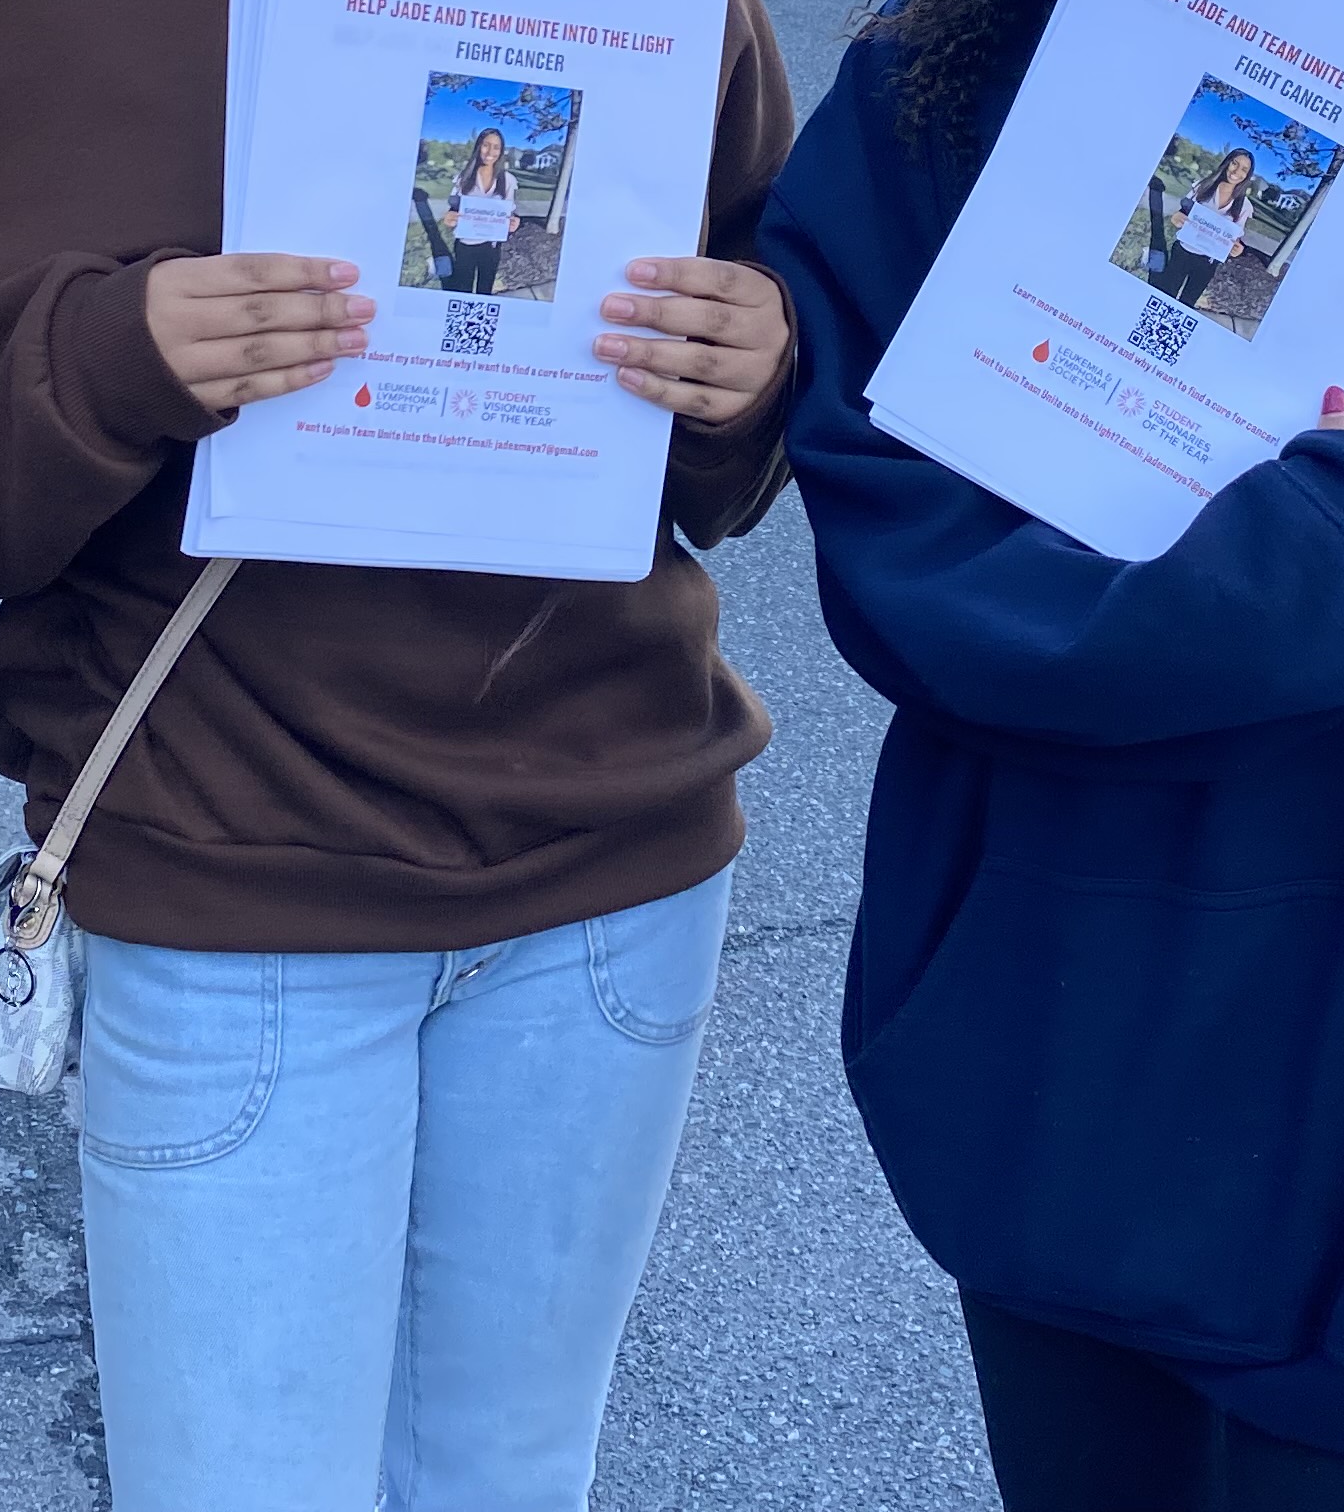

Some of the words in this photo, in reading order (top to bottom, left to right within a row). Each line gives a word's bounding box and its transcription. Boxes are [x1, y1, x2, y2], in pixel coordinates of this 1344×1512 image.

[390, 0, 432, 22] JADE
[434, 6, 466, 27] AND
[470, 10, 512, 33] TEAM
[515, 17, 561, 40] UNITE
[562, 23, 598, 45] INTO
[601, 29, 629, 49] THE
[632, 33, 675, 55] LIGHT
[1225, 14, 1259, 42] AND
[1259, 30, 1303, 65] TEAM
[455, 41, 502, 64] FIGHT
[505, 47, 565, 72] CANCER
[1234, 54, 1282, 90] FIGHT
[1280, 79, 1343, 124] CANCER
[1012, 284, 1036, 304] Learn
[1036, 299, 1058, 316] more
[1058, 312, 1083, 330] about
[1082, 326, 1095, 339] my
[1095, 332, 1119, 352] story
[1118, 347, 1135, 361] and
[1134, 355, 1152, 373] why
[1156, 369, 1179, 387] want
[1177, 380, 1187, 392] to
[1188, 386, 1206, 402] find
[1211, 402, 1231, 418] cure
[1231, 413, 1247, 425] for
[1245, 422, 1280, 447] cancer!
[1048, 362, 1090, 390] SOCIETY
[1053, 353, 1107, 391] LYMPHOMA
[1058, 345, 1103, 378] LEUKEMIA
[376, 392, 437, 405] LYMPHOMA
[378, 383, 430, 394] LEUKEMIA
[485, 391, 536, 403] STUDENT
[973, 348, 995, 367] Want
[994, 361, 1004, 373] to
[1002, 367, 1020, 383] join
[1019, 376, 1041, 396] Team
[1040, 389, 1063, 409] Unite
[1062, 403, 1080, 419] Into
[1079, 412, 1094, 428] the
[1093, 421, 1121, 443] Light?
[1119, 436, 1144, 458] Email:
[375, 401, 422, 413] SOCIETY
[481, 412, 496, 423] OF
[500, 414, 521, 425] THE
[483, 402, 551, 416] VISIONARIES
[1153, 400, 1202, 432] STUDENT
[1142, 419, 1159, 432] OF
[1159, 428, 1180, 446] THE
[1148, 409, 1211, 452] VISIONARIES
